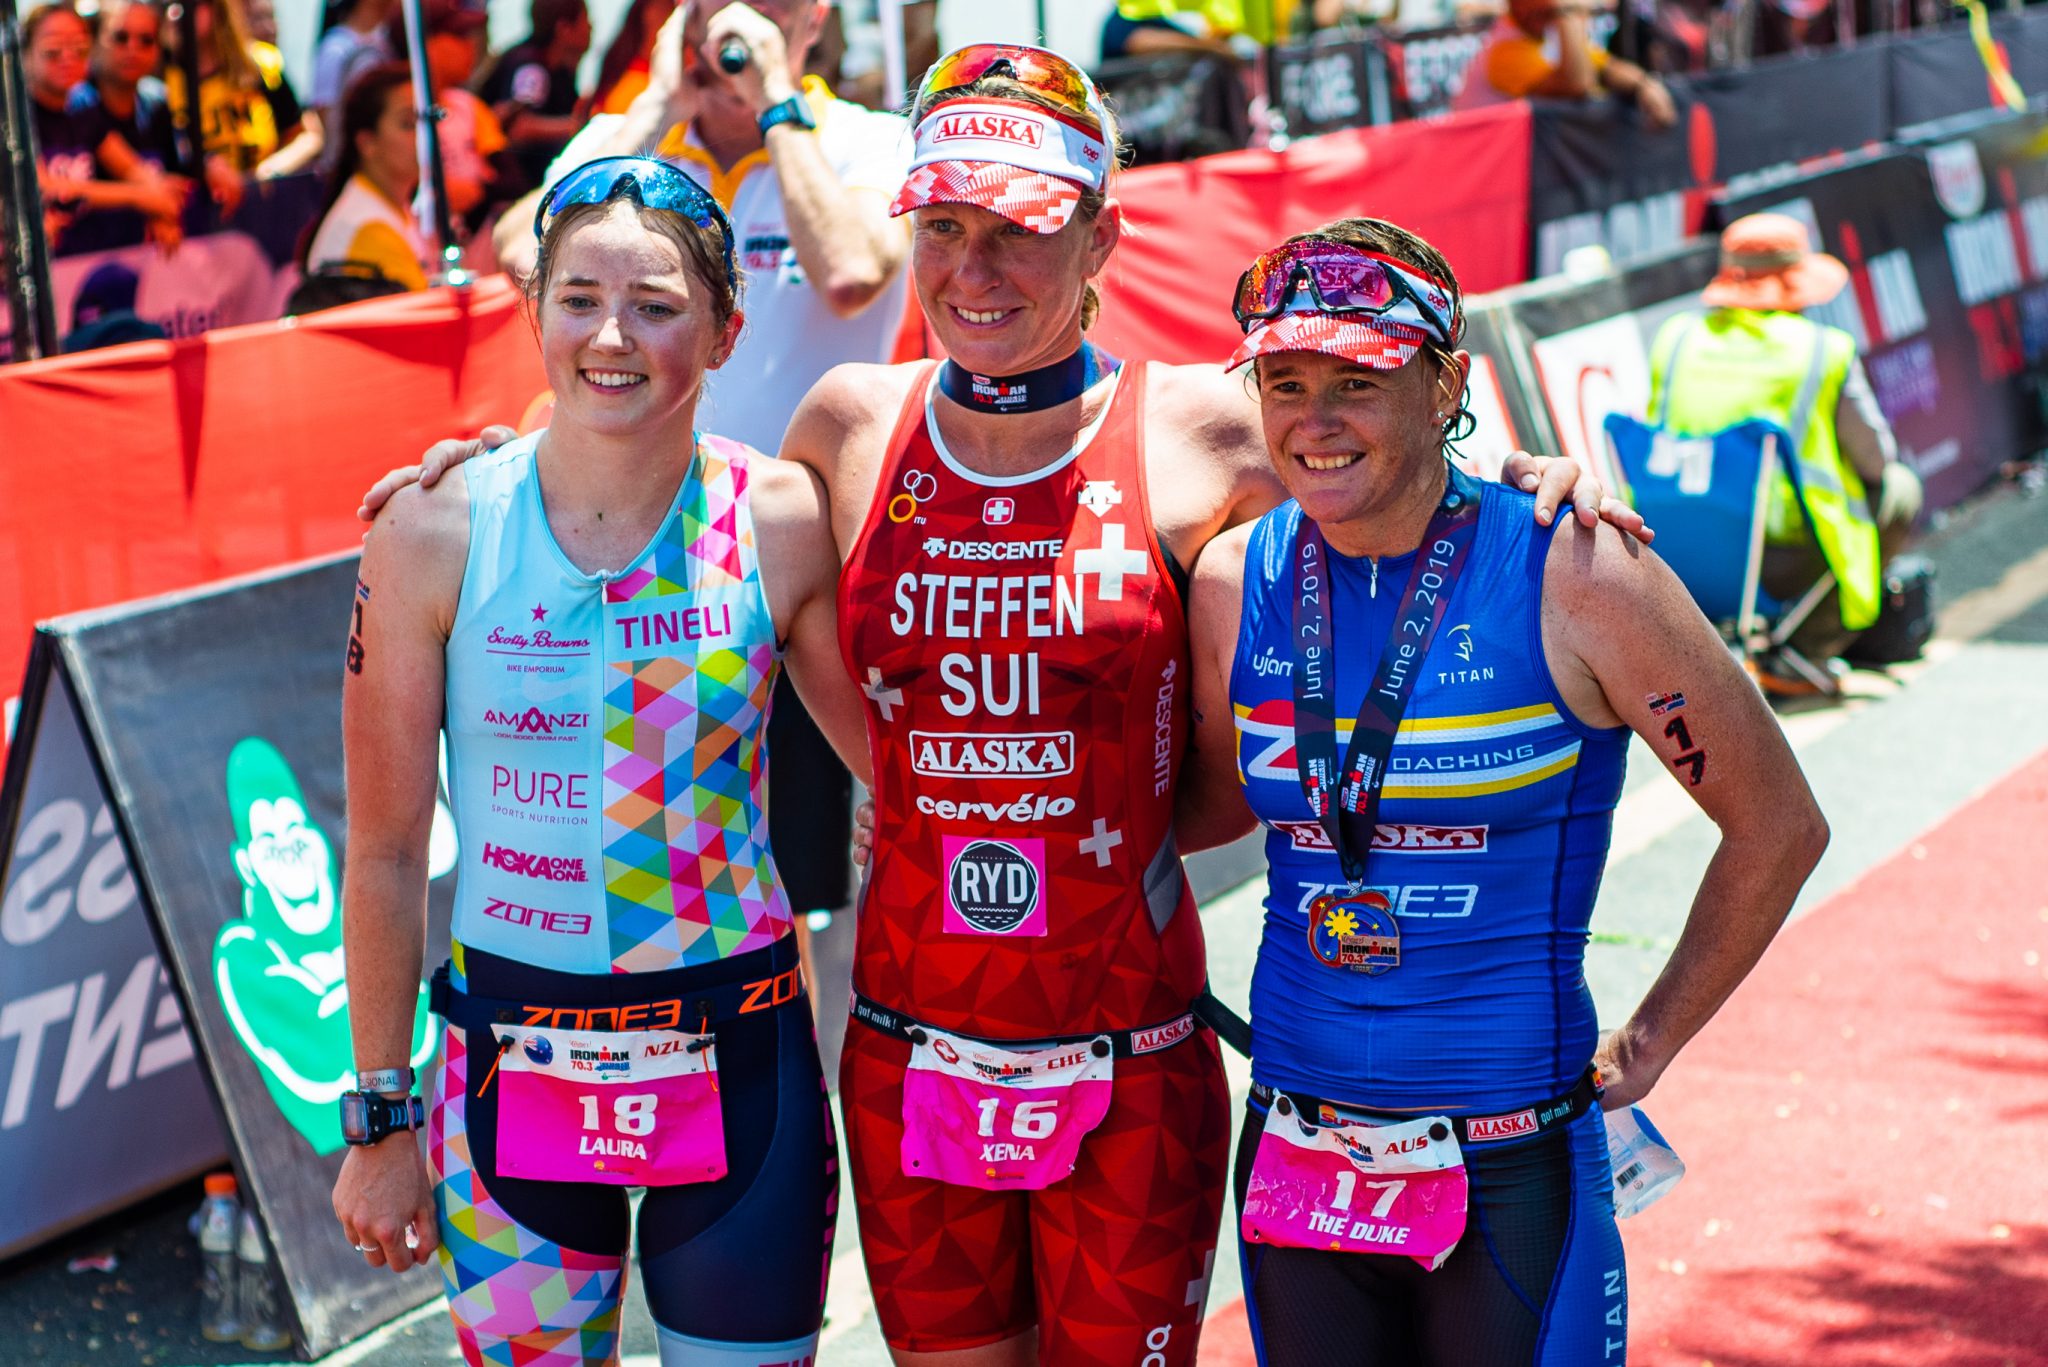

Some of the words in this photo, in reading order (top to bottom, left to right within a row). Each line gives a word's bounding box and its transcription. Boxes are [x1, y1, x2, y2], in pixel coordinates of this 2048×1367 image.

[936, 116, 1038, 145] ALASKA
[972, 382, 1027, 396] IRONMAN
[948, 539, 1063, 560] DESCENTE
[1302, 542, 1320, 607] 2019
[890, 571, 1084, 638] STEFFEN
[1380, 642, 1415, 700] June
[1415, 540, 1455, 607] 2019
[529, 630, 590, 648] Browns
[615, 603, 732, 648] TINELI
[506, 664, 522, 672] BIKE
[523, 665, 565, 673] EMPORIUM
[1303, 646, 1323, 700] June
[1438, 668, 1494, 684] TITAN
[939, 652, 1040, 717] SUI
[483, 706, 590, 733] AMANZI
[1154, 682, 1174, 797] DESCENTE
[1664, 714, 1706, 786] 17
[917, 740, 1066, 772] ALASKA
[493, 765, 588, 809] PURE
[1347, 753, 1369, 812] IRONMAN
[491, 804, 525, 820] SPORTS
[528, 813, 588, 825] NUTRITION
[916, 793, 1076, 822] cervélo
[1294, 825, 1480, 848] ALSKA
[482, 842, 553, 881] HOKA
[551, 857, 583, 870] ONE
[960, 861, 1028, 904] RYD
[483, 897, 592, 935] ZONE3
[1341, 941, 1397, 955] IRONMAN
[522, 1000, 681, 1030] ZONE3
[1137, 1019, 1191, 1050] ALASKA
[570, 1046, 630, 1061] IRONMAN
[644, 1040, 684, 1058] NZL
[571, 1060, 594, 1072] 70.3
[1047, 1051, 1087, 1070] CHE
[578, 1094, 658, 1136] 18
[978, 1097, 1058, 1139] 16
[1472, 1115, 1534, 1137] ALASKA
[579, 1136, 647, 1160] LAURA
[979, 1143, 1035, 1162] XENA
[1385, 1135, 1428, 1155] AUS
[1330, 1171, 1406, 1217] 17
[1308, 1212, 1347, 1236] THE
[1349, 1222, 1410, 1244] DUKE
[1604, 1268, 1623, 1367] TAN
